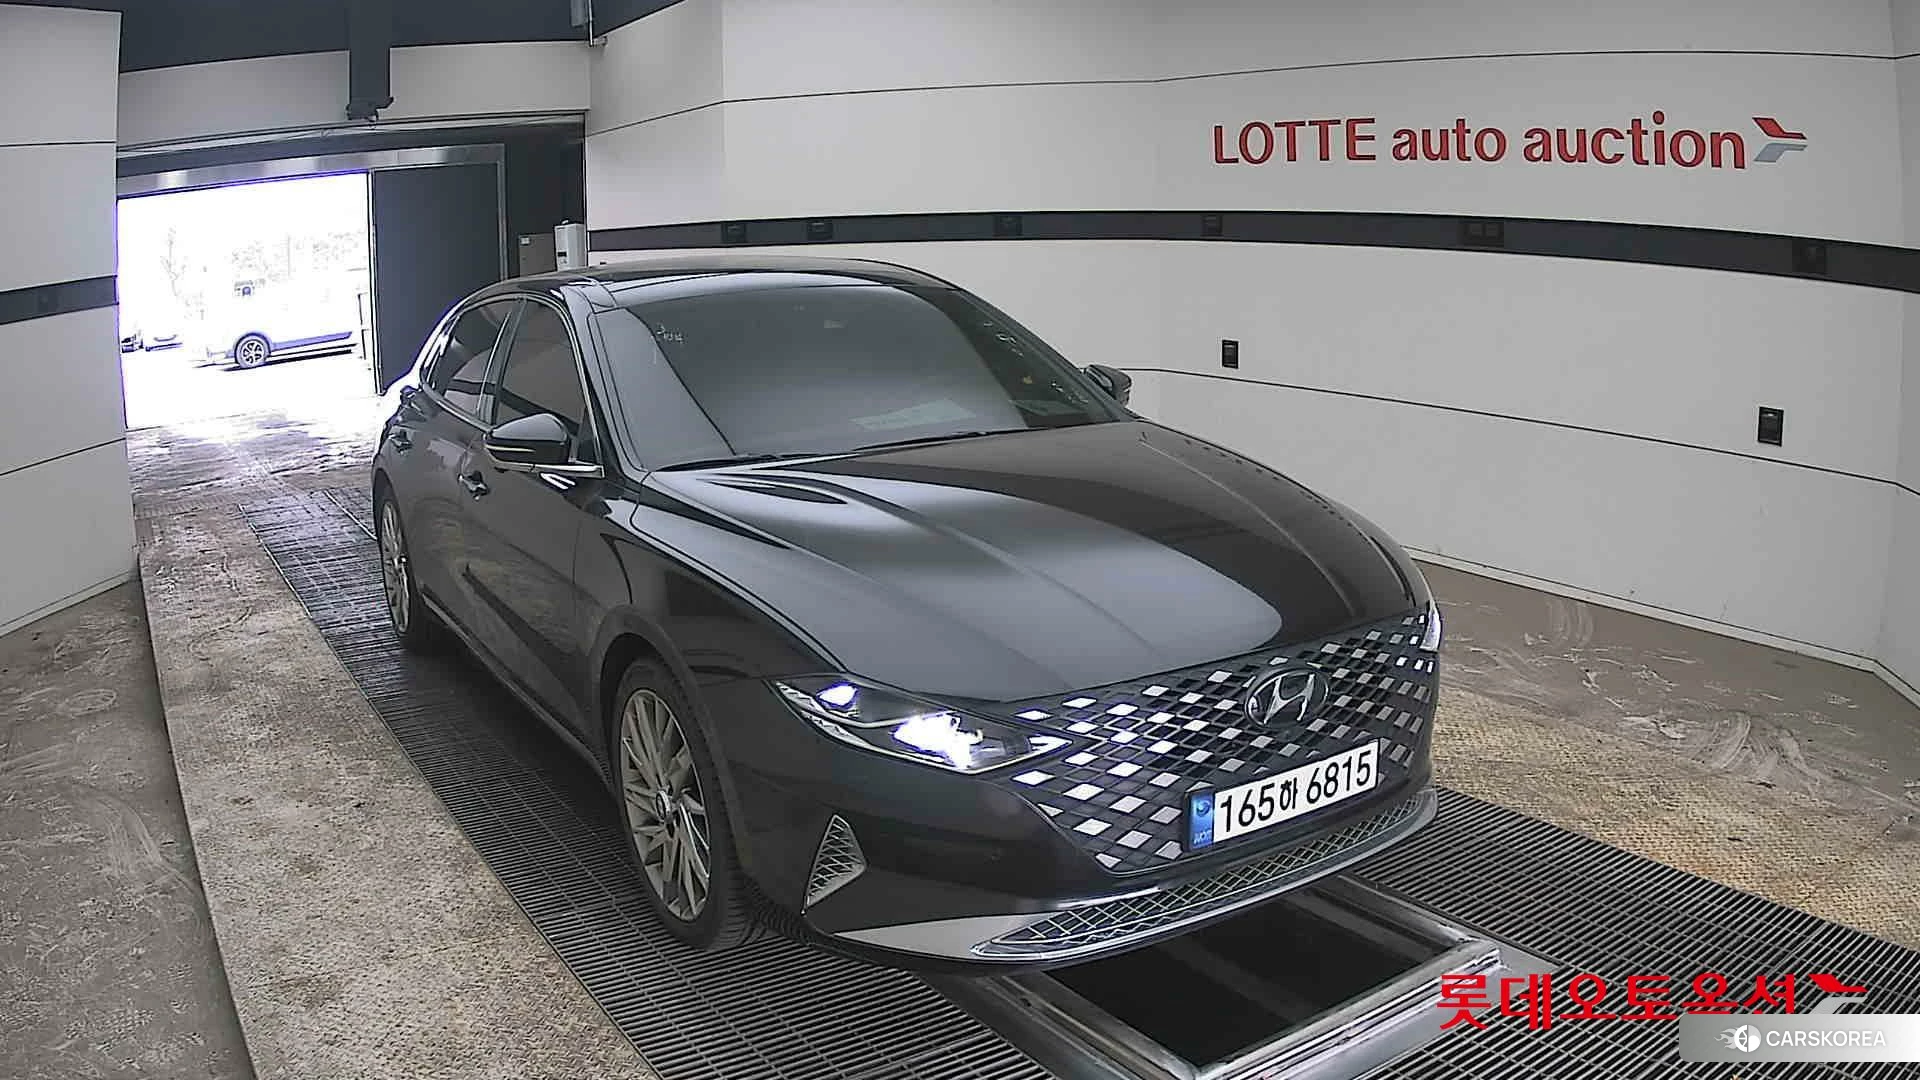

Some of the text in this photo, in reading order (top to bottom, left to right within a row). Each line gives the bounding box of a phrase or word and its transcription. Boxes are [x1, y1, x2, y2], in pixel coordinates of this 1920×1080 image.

[1213, 110, 1745, 168] LOTTE auto auction
[1220, 750, 1371, 833] 165하 6815
